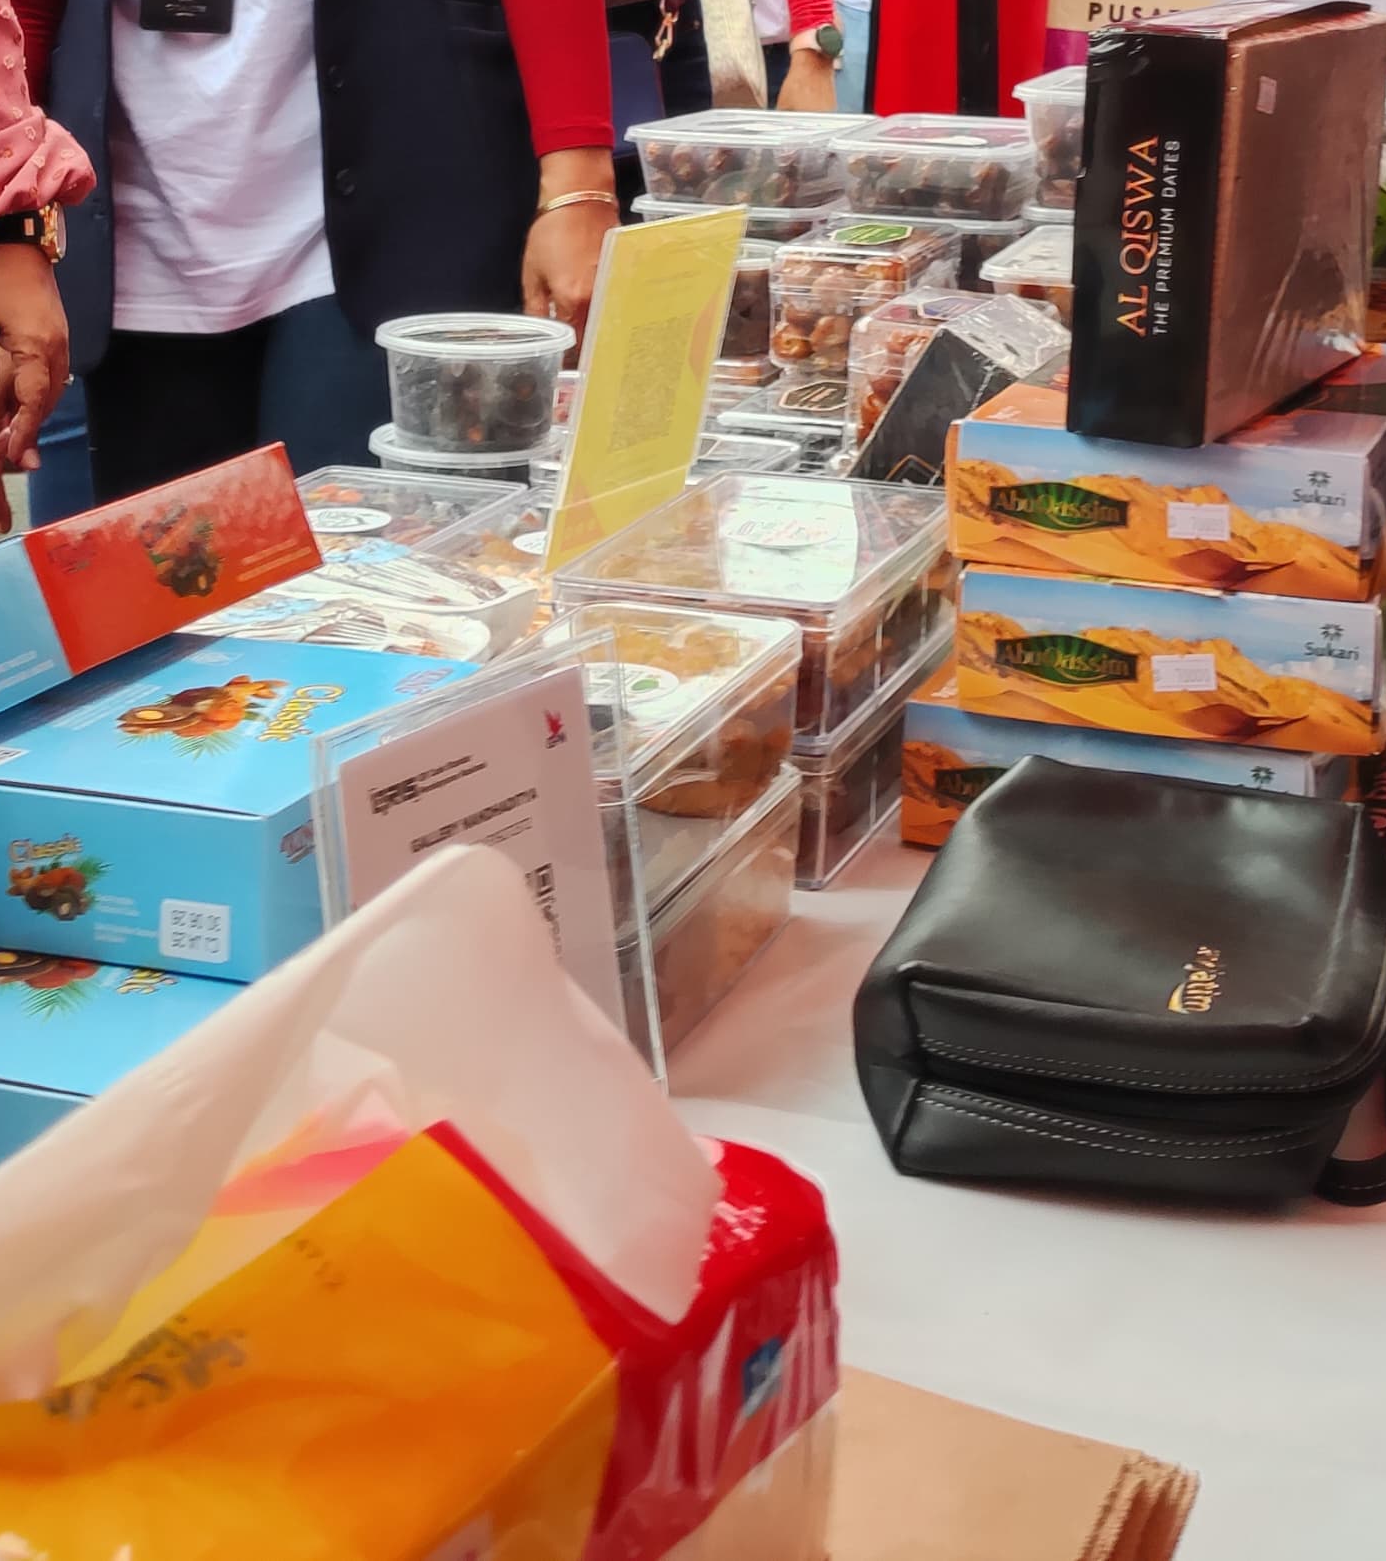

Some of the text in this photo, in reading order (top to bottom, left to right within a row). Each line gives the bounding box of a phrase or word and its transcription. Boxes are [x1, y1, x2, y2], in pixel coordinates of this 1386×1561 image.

[1088, 2, 1181, 23] PUS
[1117, 135, 1159, 337] AL QISWA
[1153, 140, 1181, 336] THE PREMIUM DATES
[1292, 486, 1347, 507] Sukari
[1304, 641, 1359, 661] Sukari
